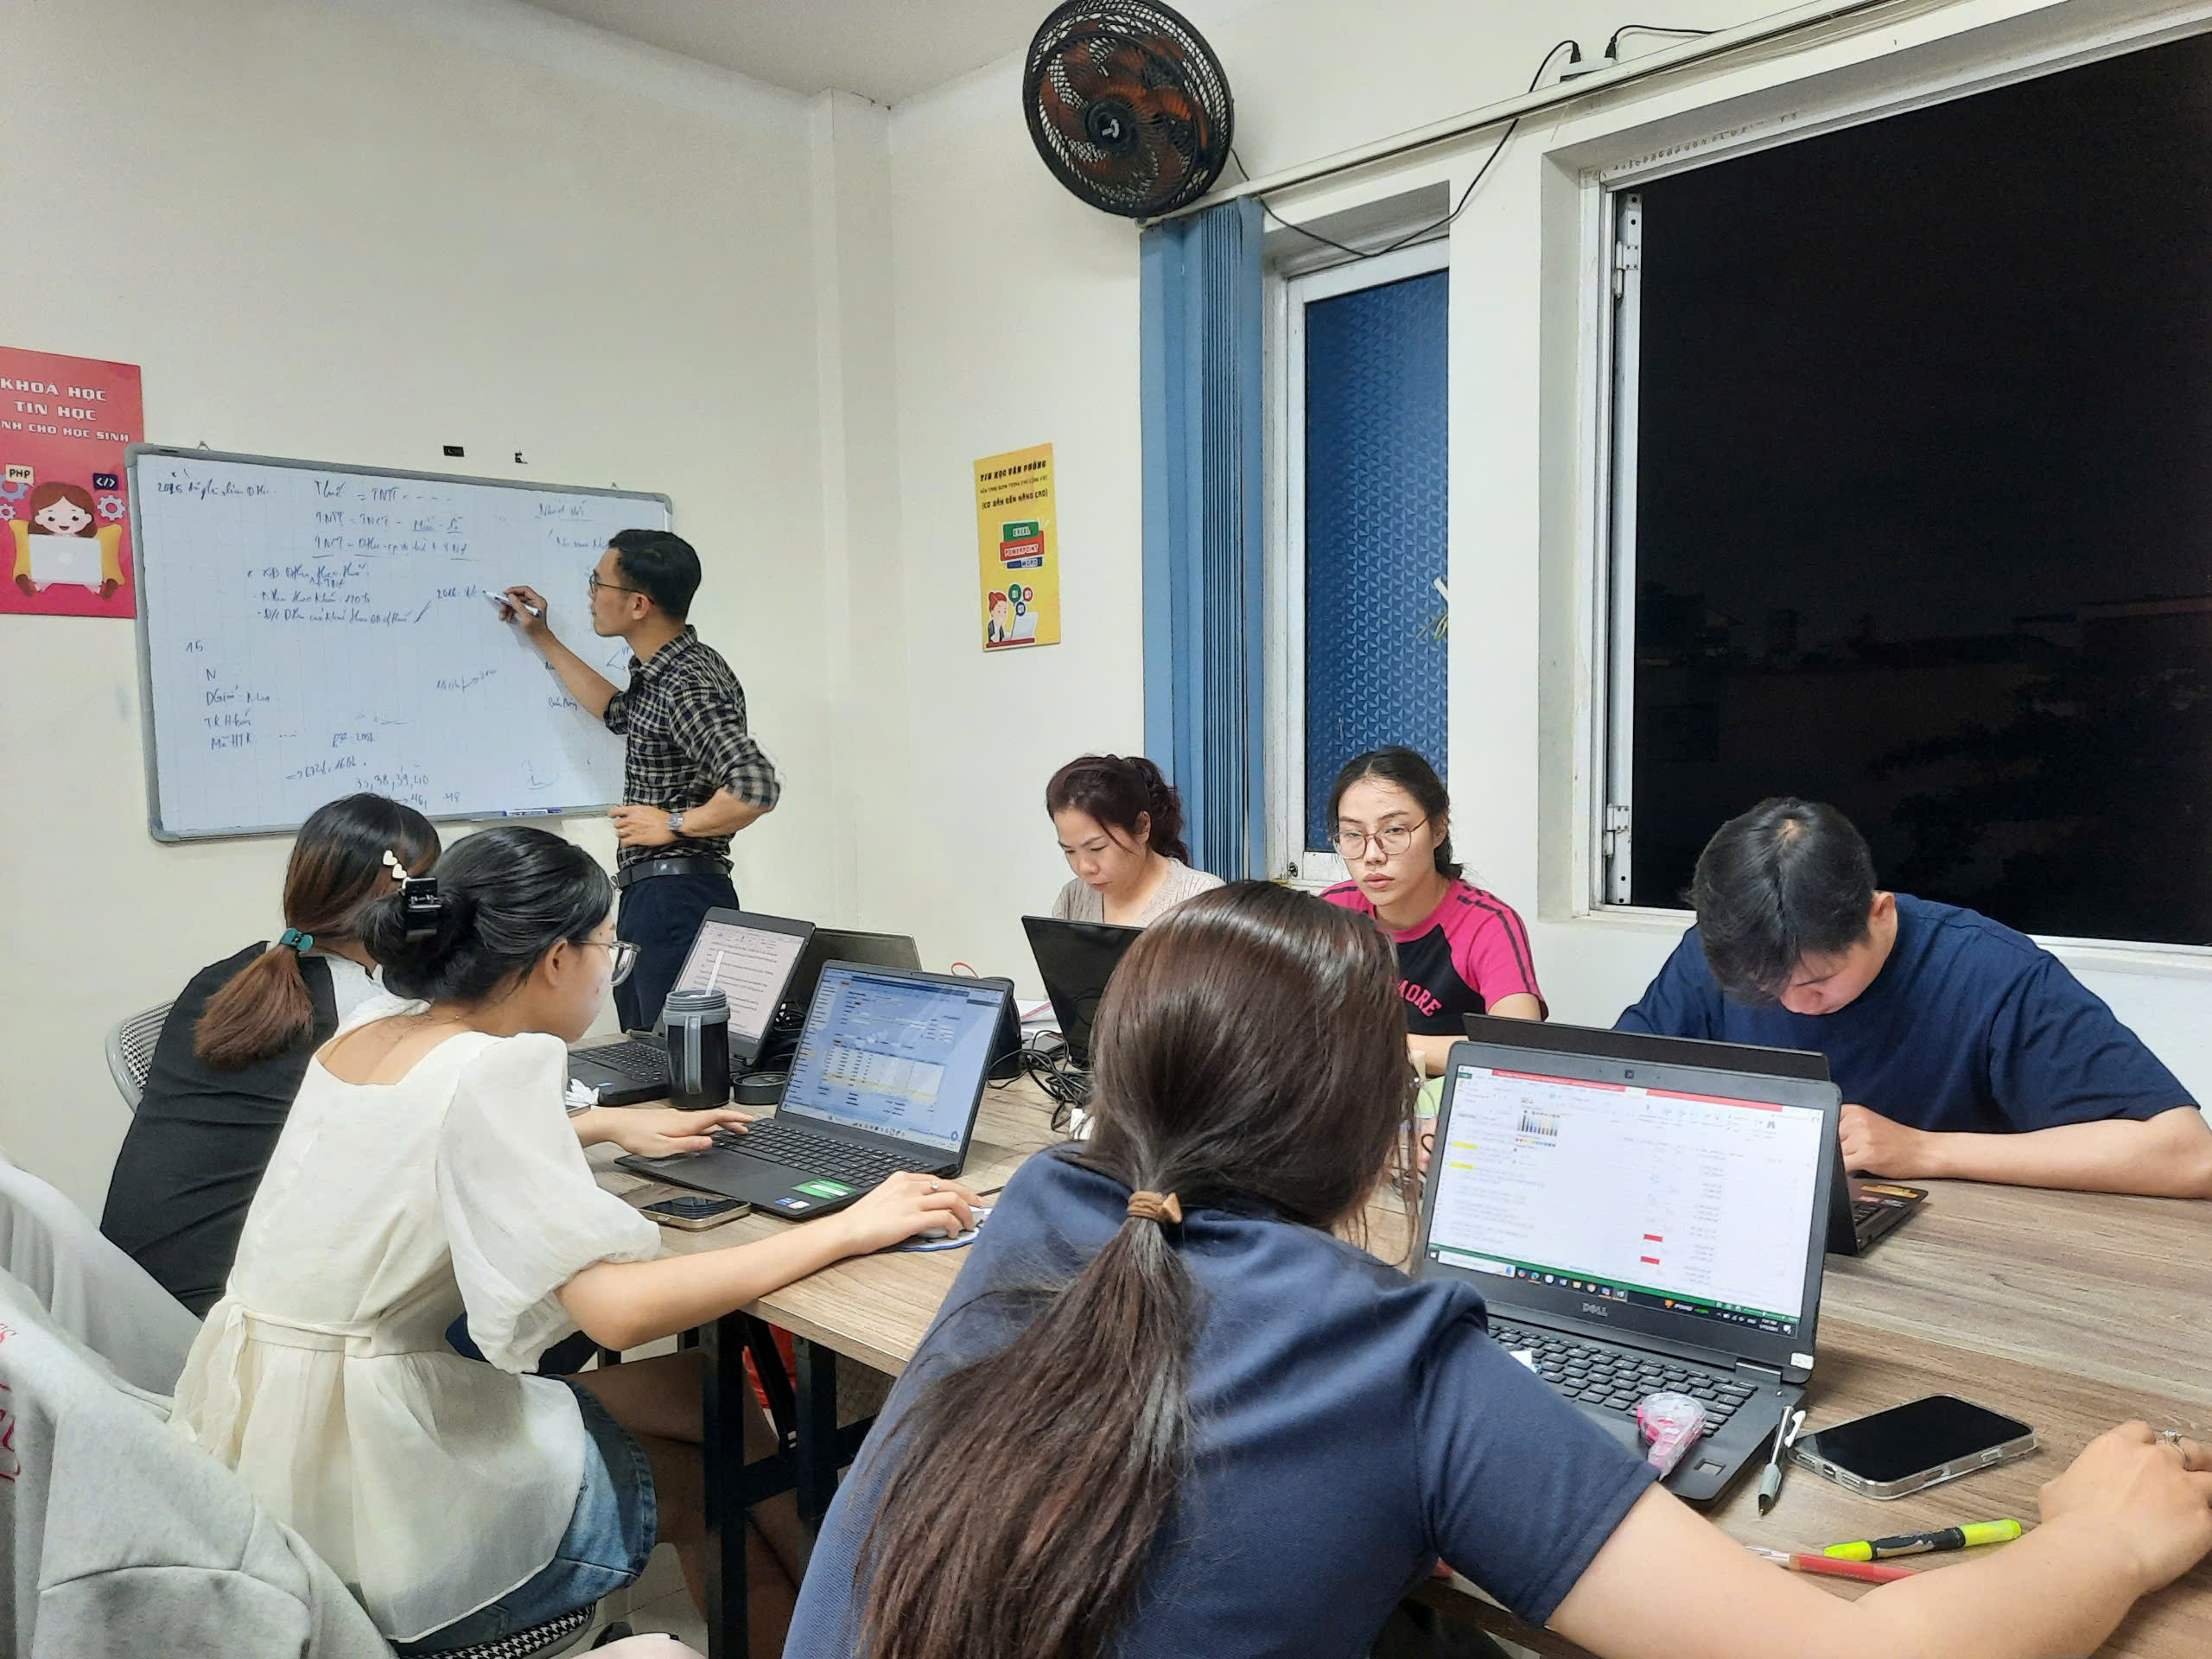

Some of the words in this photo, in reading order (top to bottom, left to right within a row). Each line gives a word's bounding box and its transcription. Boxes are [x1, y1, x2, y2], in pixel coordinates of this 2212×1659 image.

[68, 386, 106, 402] HỌC
[14, 400, 48, 416] TIN
[57, 405, 97, 422] HỌC
[29, 423, 57, 435] CHO
[96, 430, 130, 443] SINH
[9, 468, 31, 479] PHP
[1582, 1302, 1608, 1317] DELL
